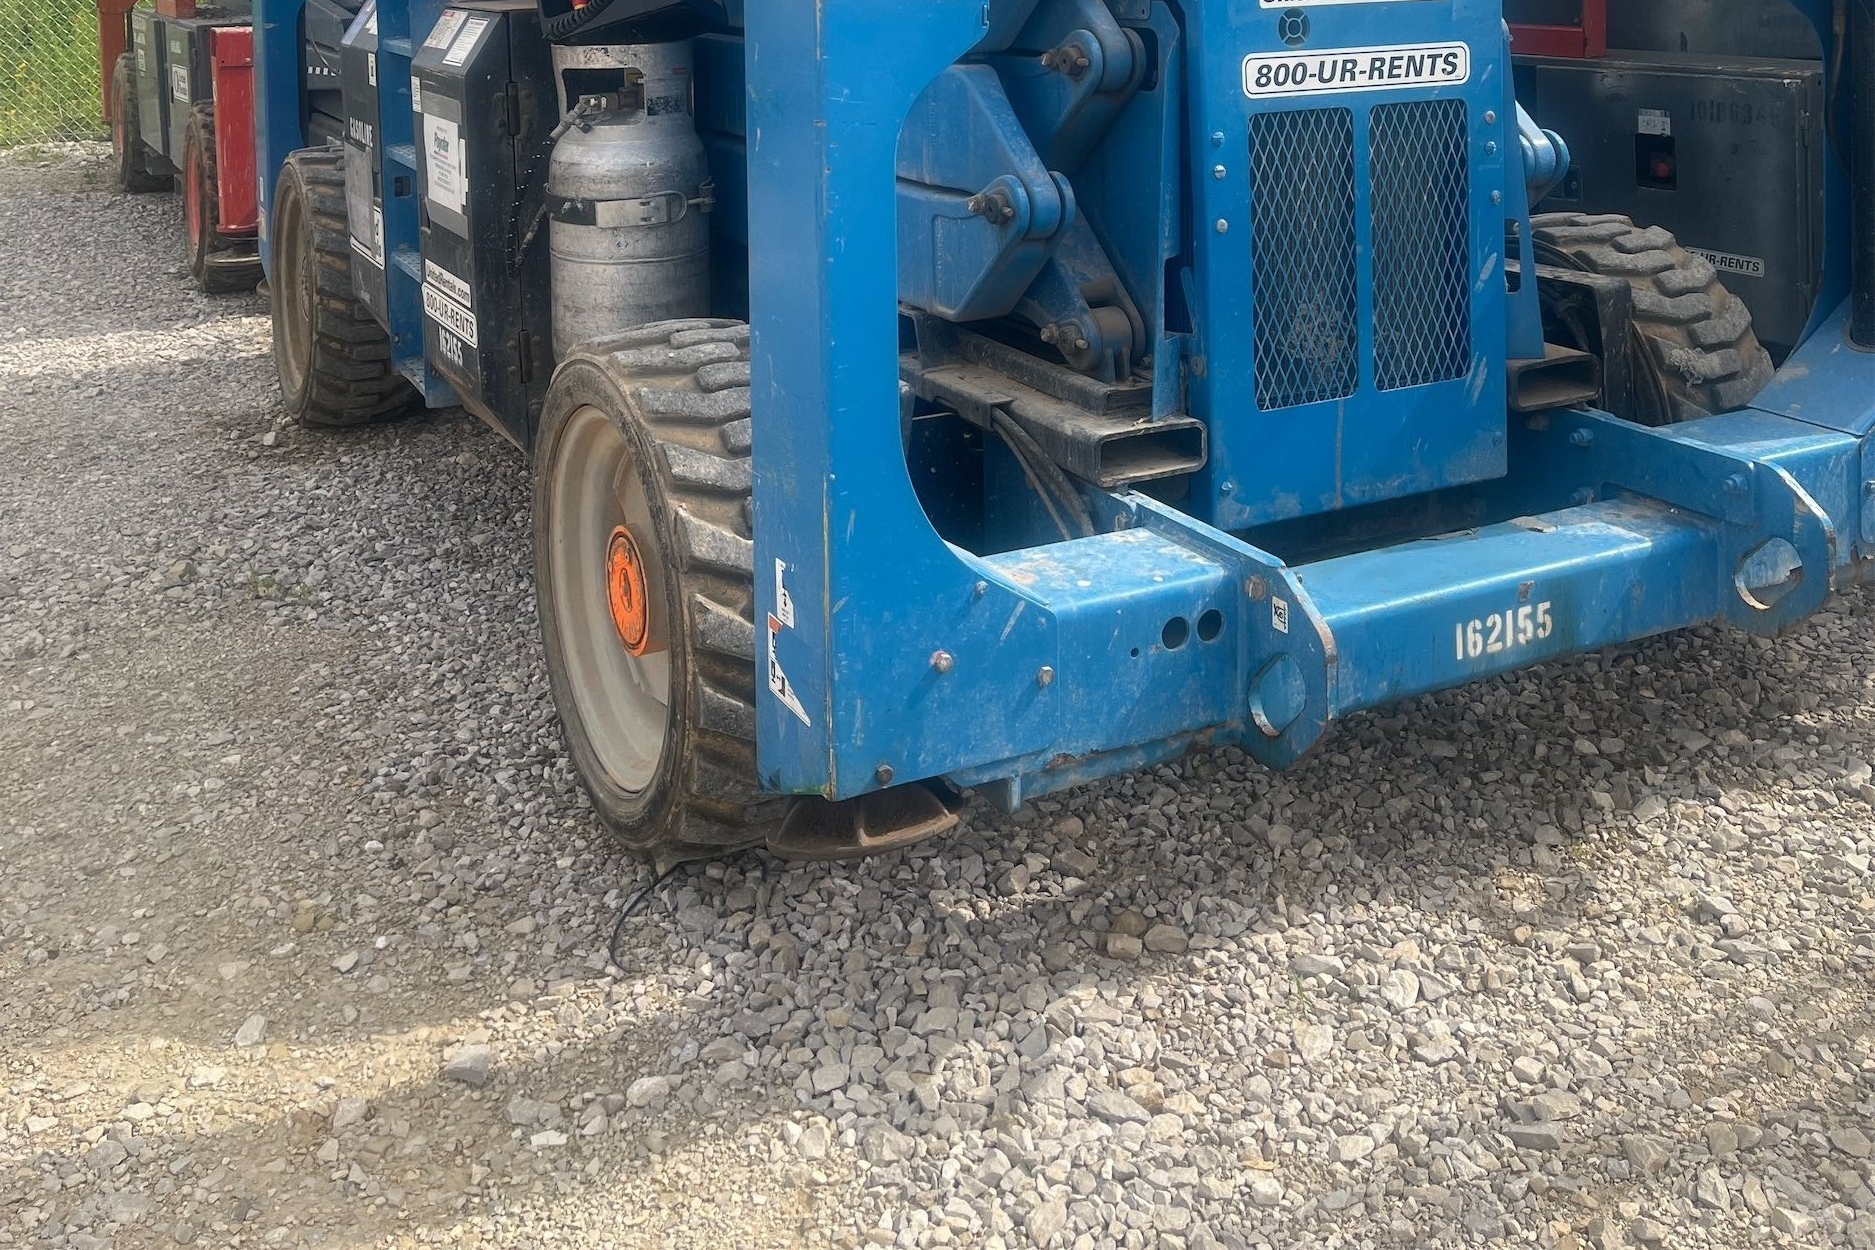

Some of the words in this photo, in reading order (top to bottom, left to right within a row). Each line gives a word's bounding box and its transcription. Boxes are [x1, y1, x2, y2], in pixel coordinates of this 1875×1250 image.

[1254, 52, 1459, 89] 800-UR-RENTS
[349, 116, 374, 148] GASOLINE
[425, 291, 474, 339] 800-UR-RENTS
[1455, 600, 1553, 661] 162155
